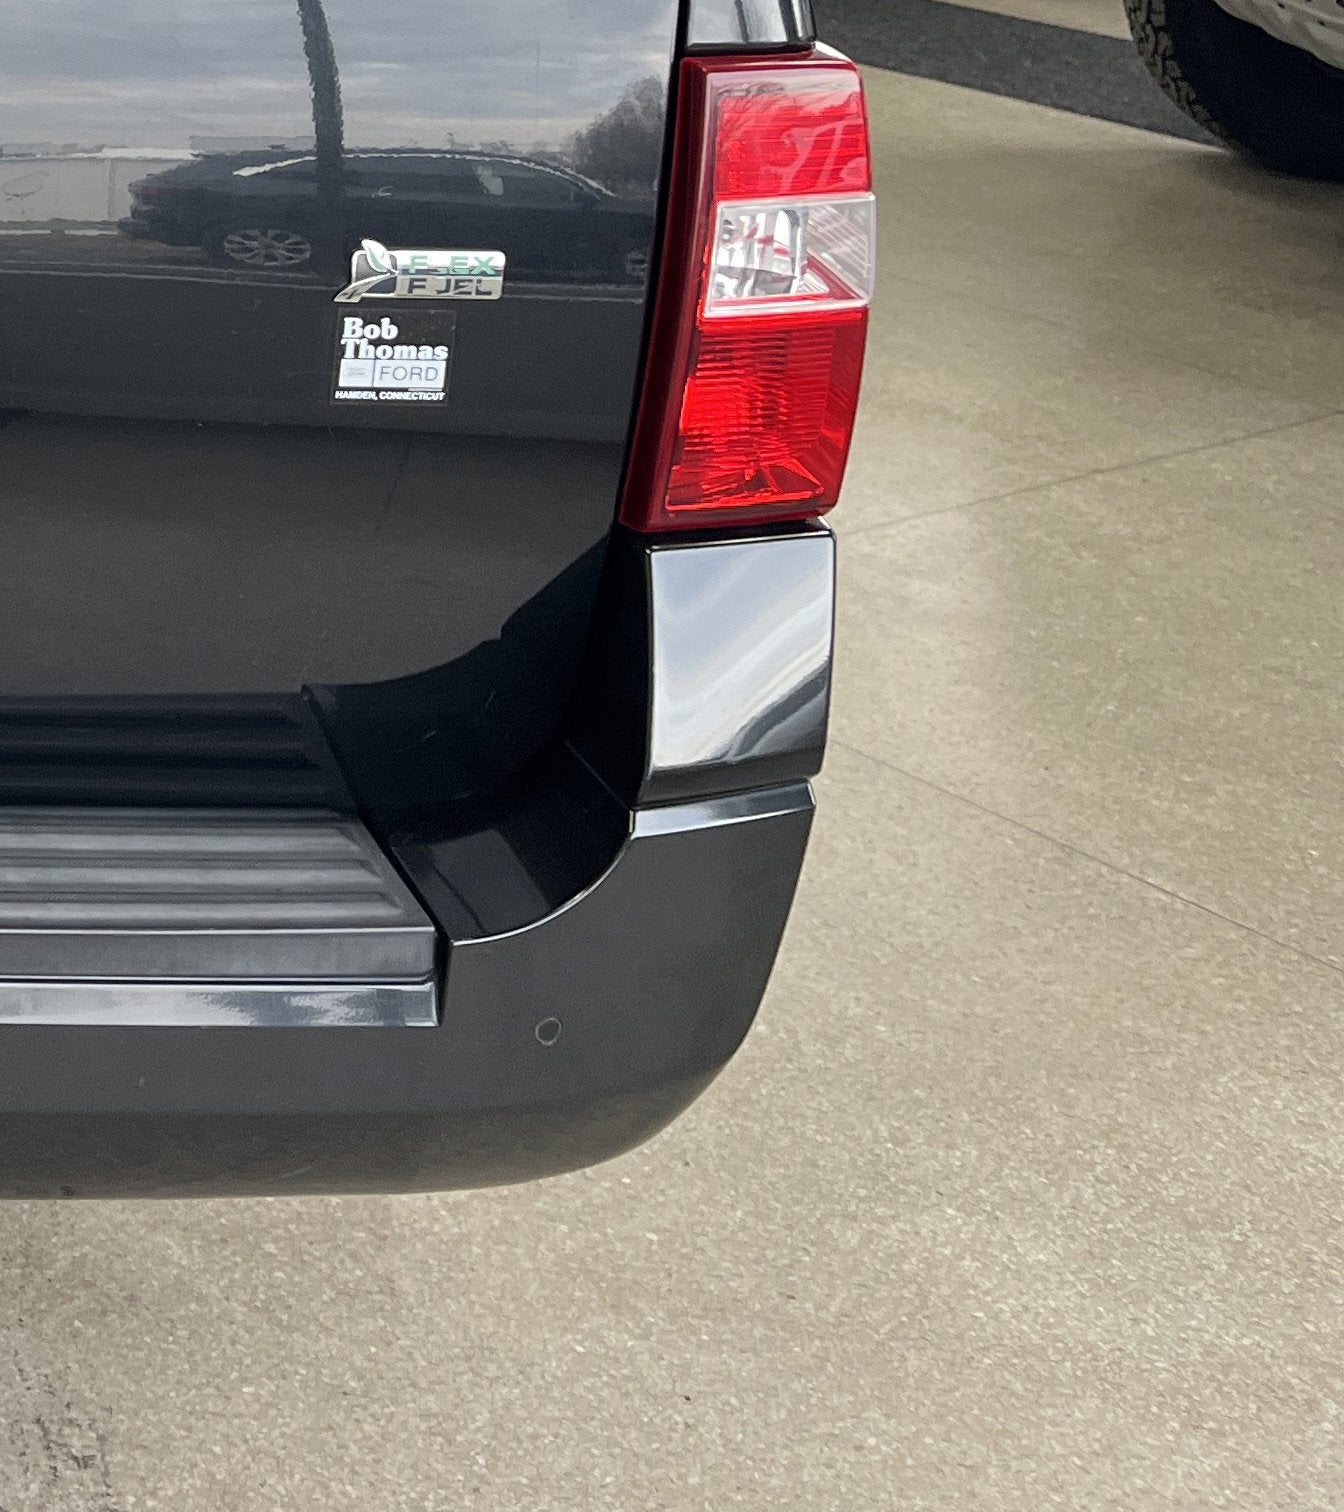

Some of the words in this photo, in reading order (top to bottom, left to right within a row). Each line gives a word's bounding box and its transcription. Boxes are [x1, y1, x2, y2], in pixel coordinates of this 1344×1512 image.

[342, 316, 399, 340] Bob
[340, 339, 449, 360] Thomas
[379, 366, 439, 382] FORD
[335, 390, 378, 401] HAMDEN,
[379, 390, 446, 401] CONNECTICUT
